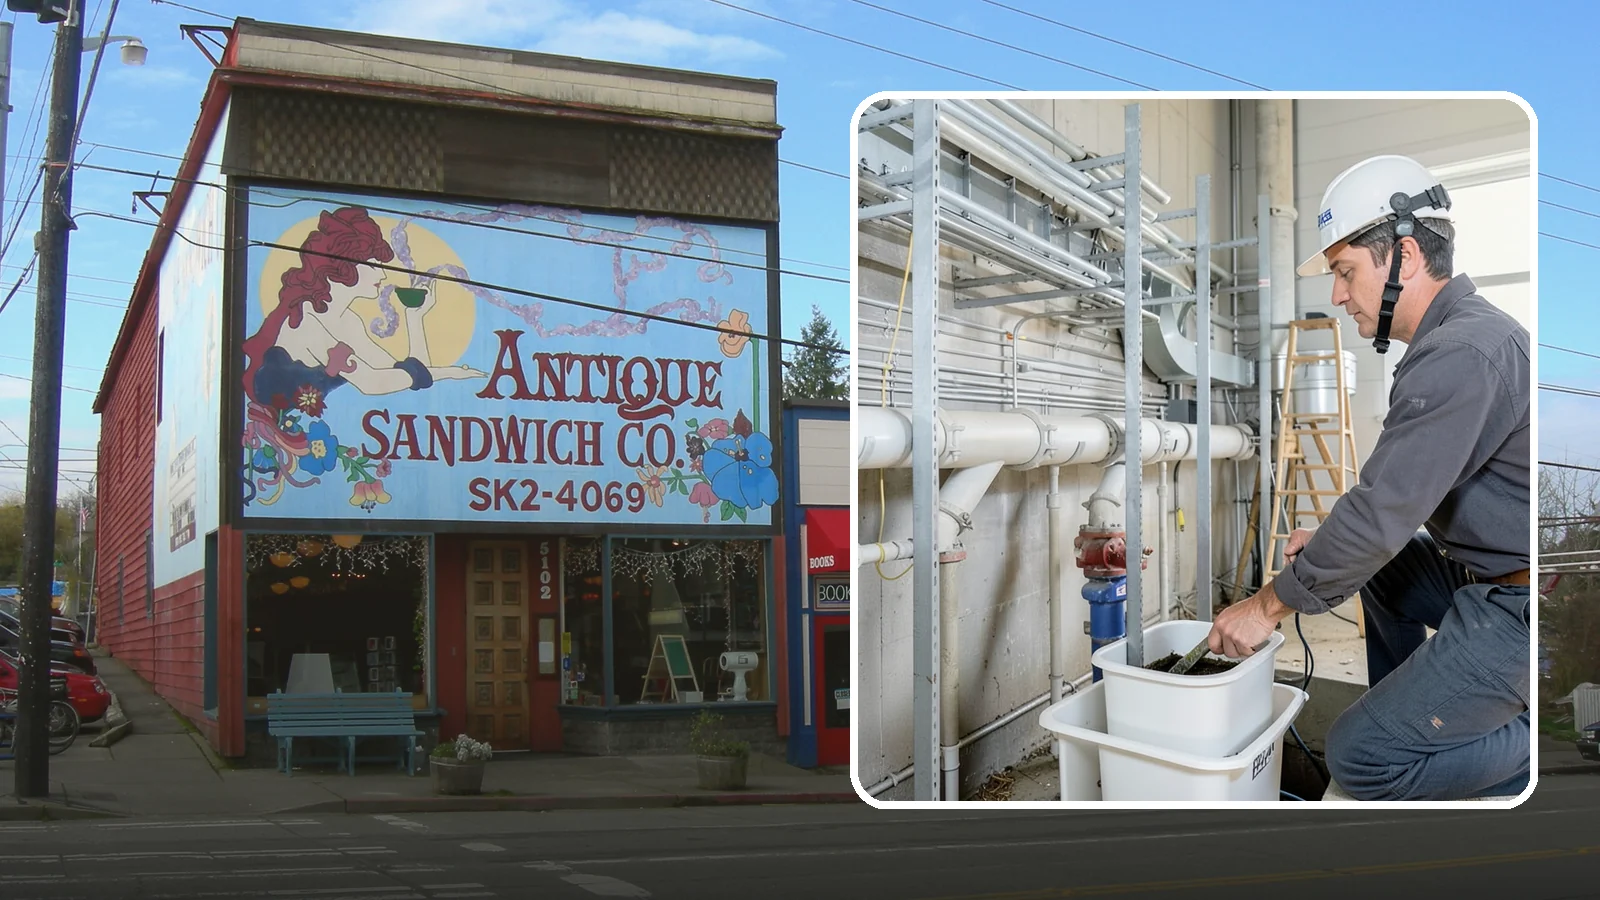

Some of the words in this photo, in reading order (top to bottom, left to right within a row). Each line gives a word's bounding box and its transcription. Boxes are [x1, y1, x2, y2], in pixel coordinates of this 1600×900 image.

[475, 328, 724, 421] ANTIQUE
[361, 408, 605, 467] SANDWICH
[617, 421, 685, 469] CO.
[468, 477, 646, 513] SK2-4069
[539, 541, 552, 600] 5102
[809, 554, 835, 569] BOOKS
